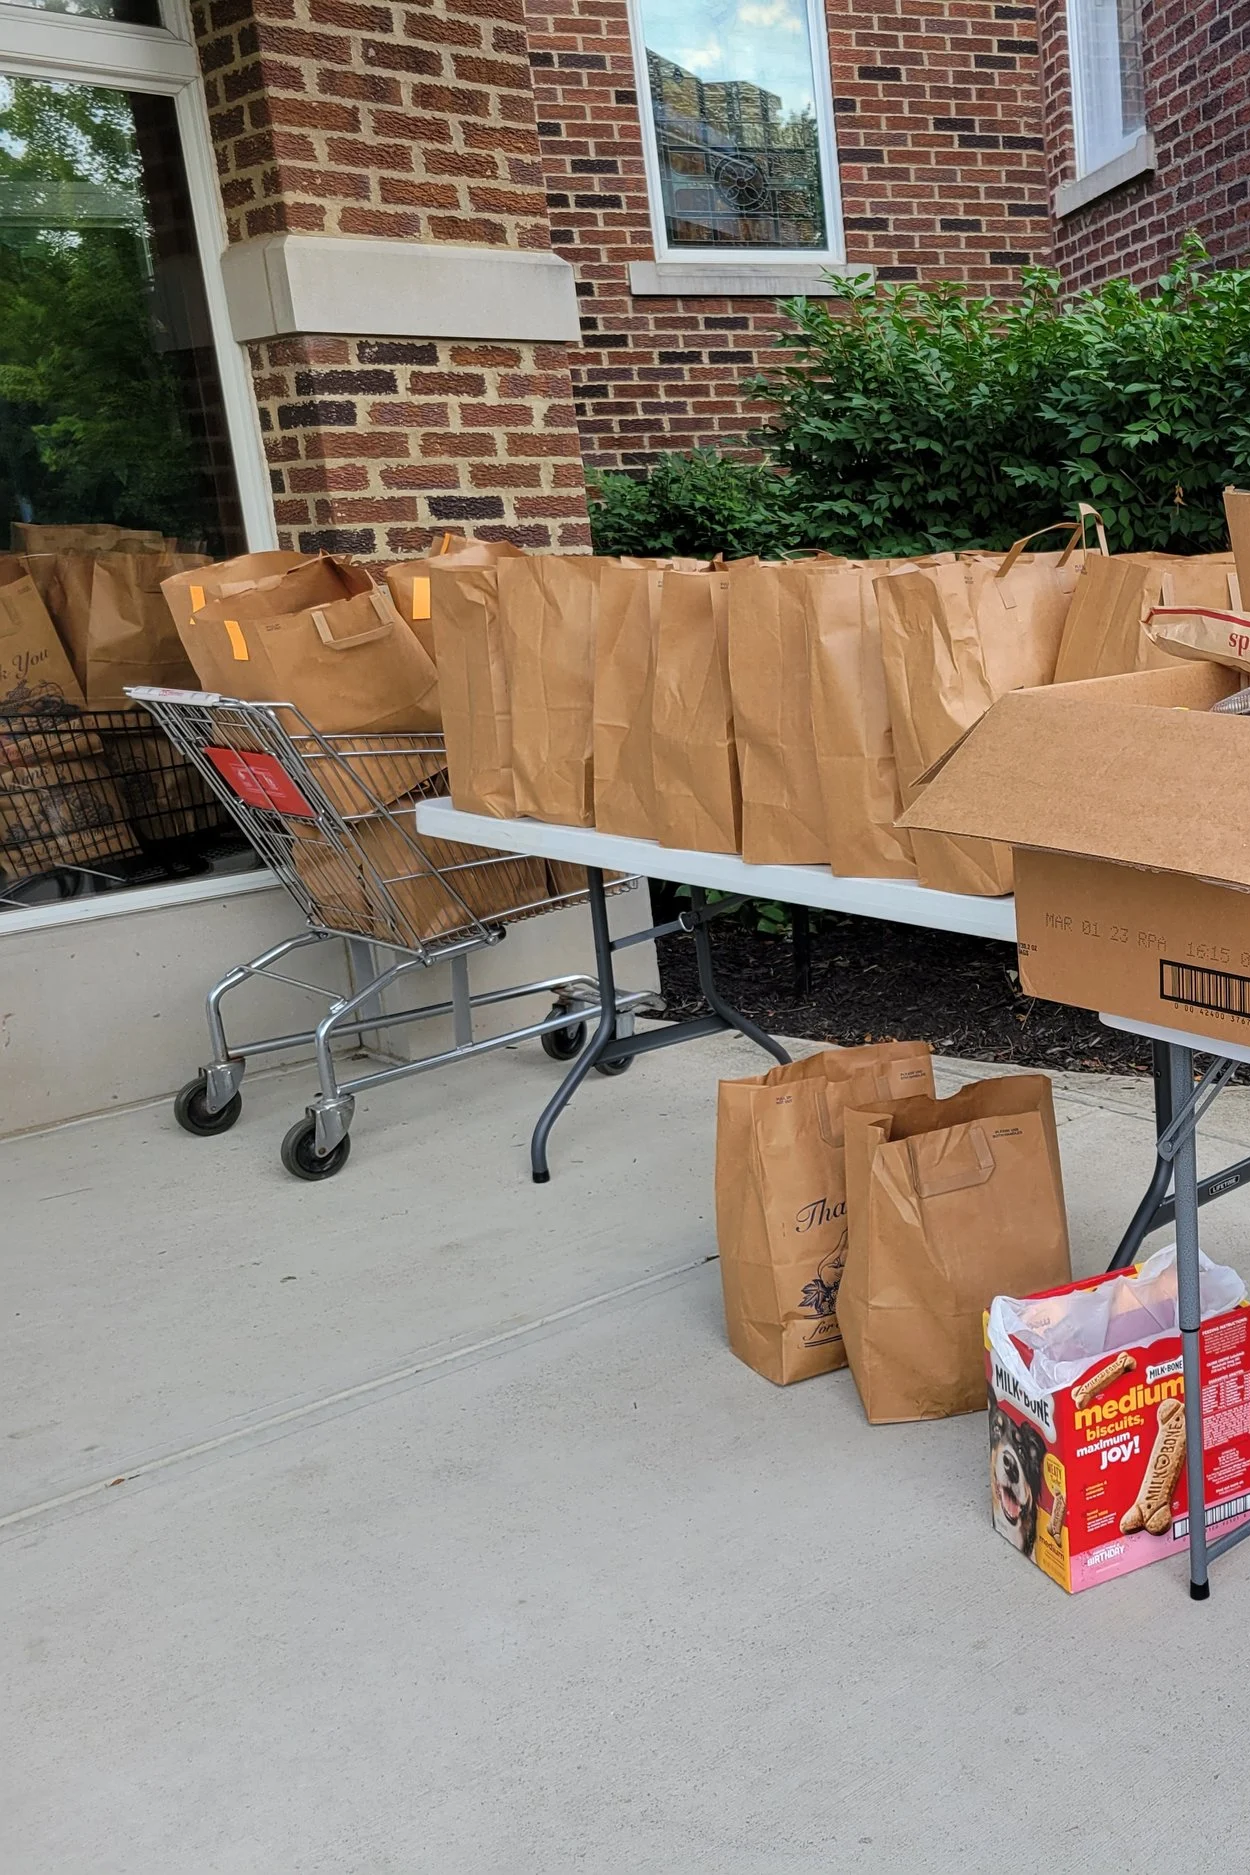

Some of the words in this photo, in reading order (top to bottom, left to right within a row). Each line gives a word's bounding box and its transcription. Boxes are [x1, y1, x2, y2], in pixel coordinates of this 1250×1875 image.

[12, 649, 49, 680] You
[1045, 912, 1073, 932] MAR
[1082, 920, 1101, 938] 01
[1110, 925, 1129, 944] 23
[1137, 931, 1167, 952] RPA
[1186, 941, 1231, 964] 16:15
[1184, 1004, 1194, 1014] 00
[1200, 1008, 1225, 1020] 42400
[1211, 1177, 1238, 1193] LIFETIME
[796, 1198, 847, 1232] Tha
[803, 1321, 834, 1340] for
[1074, 1376, 1185, 1430] medium
[1086, 1415, 1145, 1441] biscuits,
[1076, 1432, 1130, 1458] maximum
[1100, 1435, 1140, 1470] joy!
[1087, 1545, 1125, 1567] BIRTHDAY
